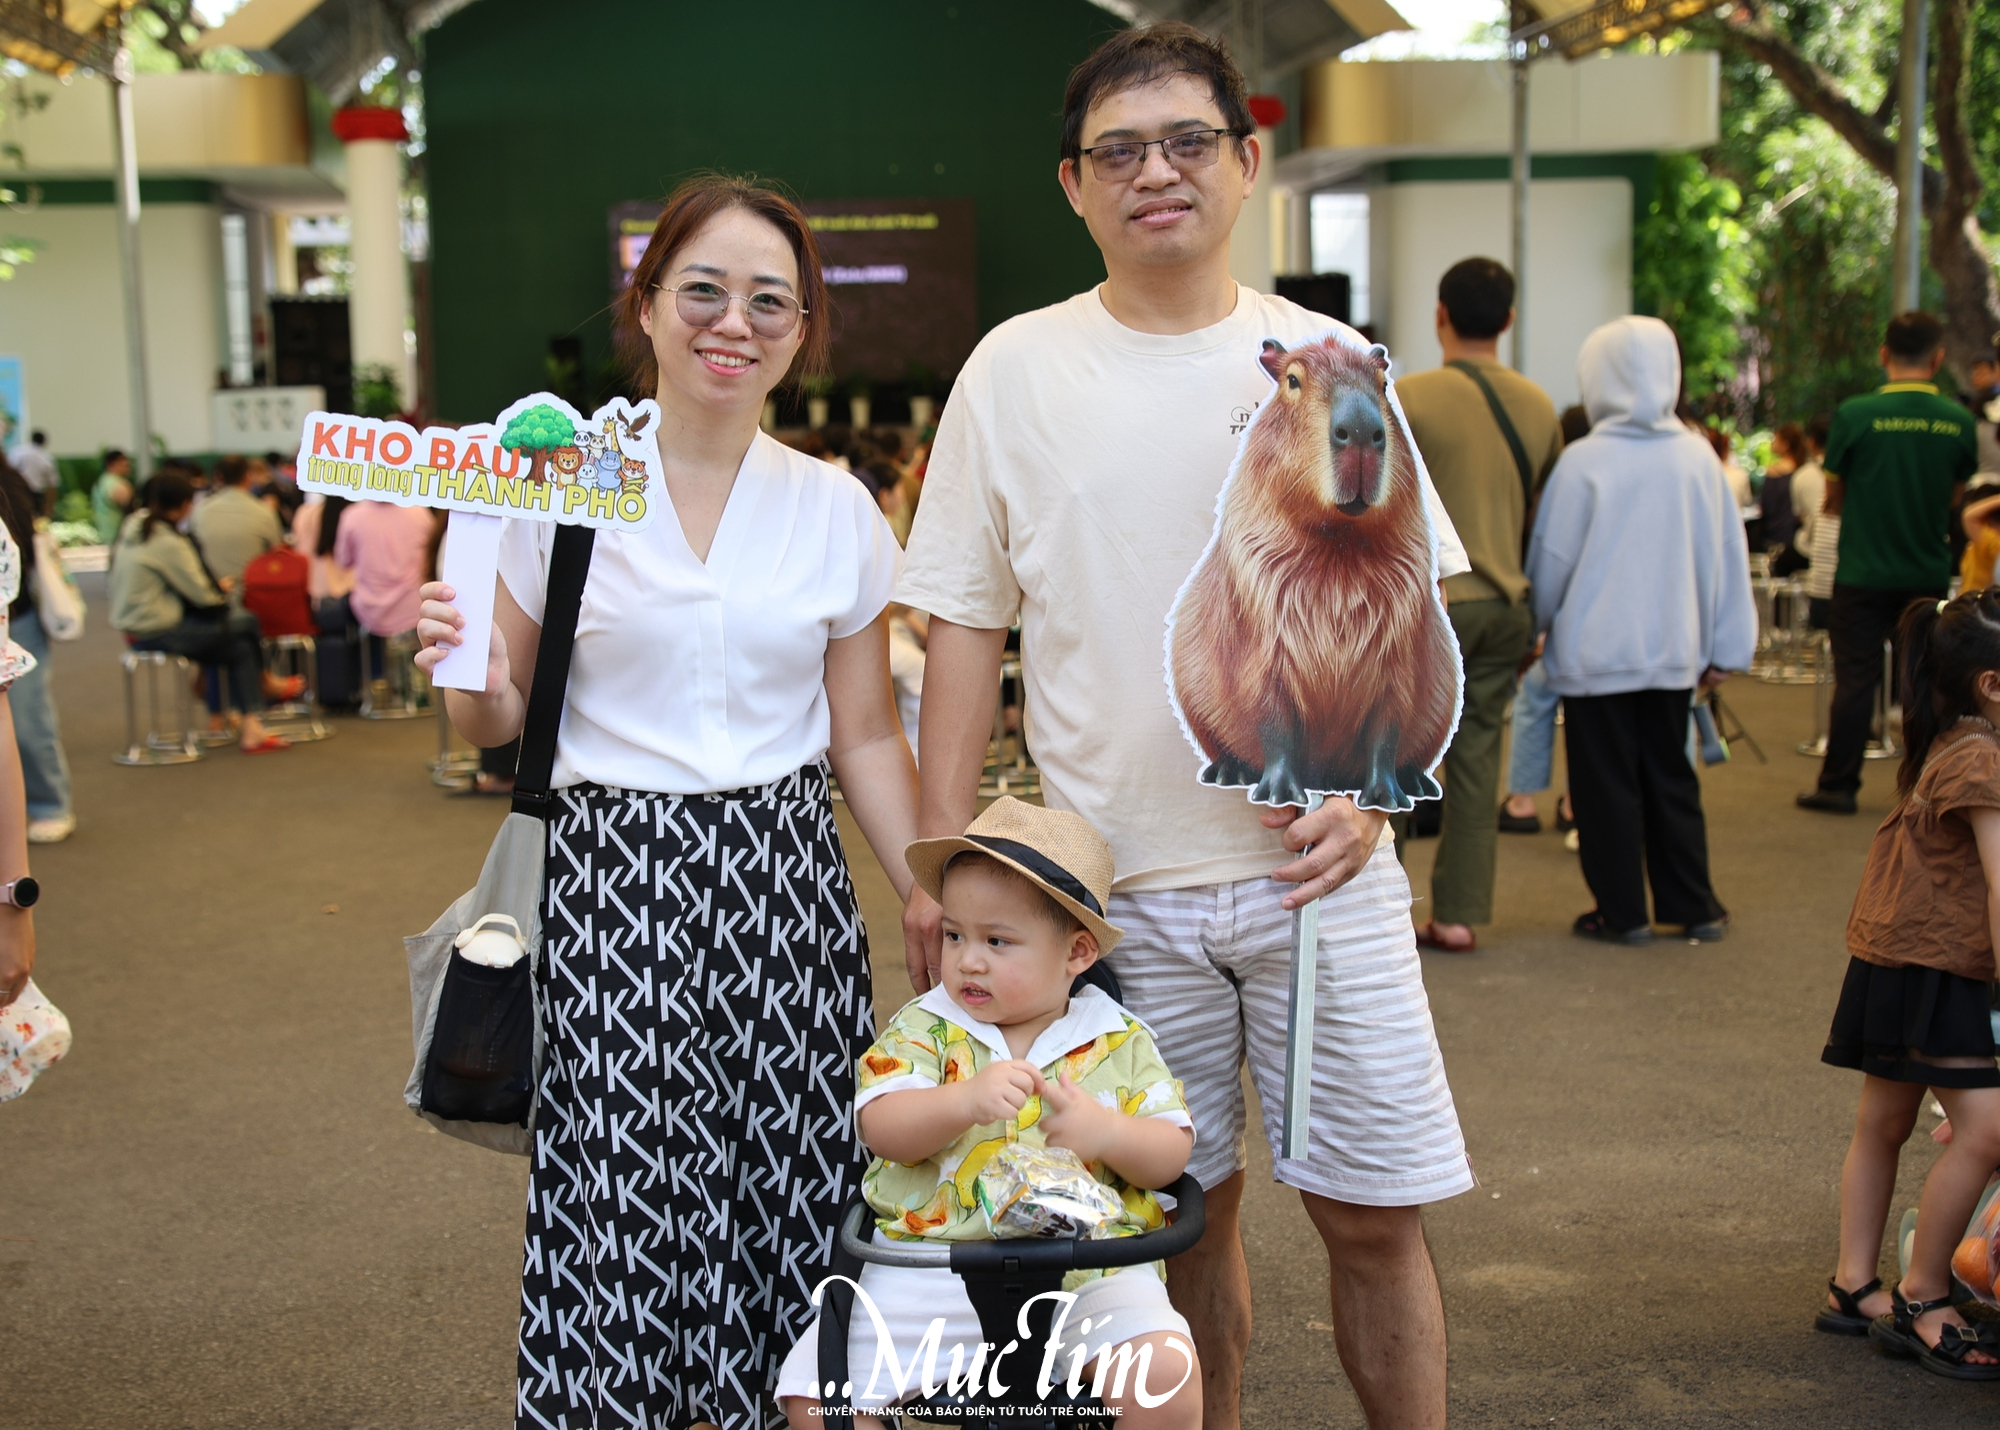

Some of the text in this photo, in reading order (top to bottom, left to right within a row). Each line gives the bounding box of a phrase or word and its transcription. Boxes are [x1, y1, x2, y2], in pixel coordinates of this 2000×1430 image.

[312, 421, 521, 479] KHO BÁU
[307, 455, 363, 491] trong
[414, 463, 552, 512] THÀNH
[563, 478, 647, 523] PHỐ
